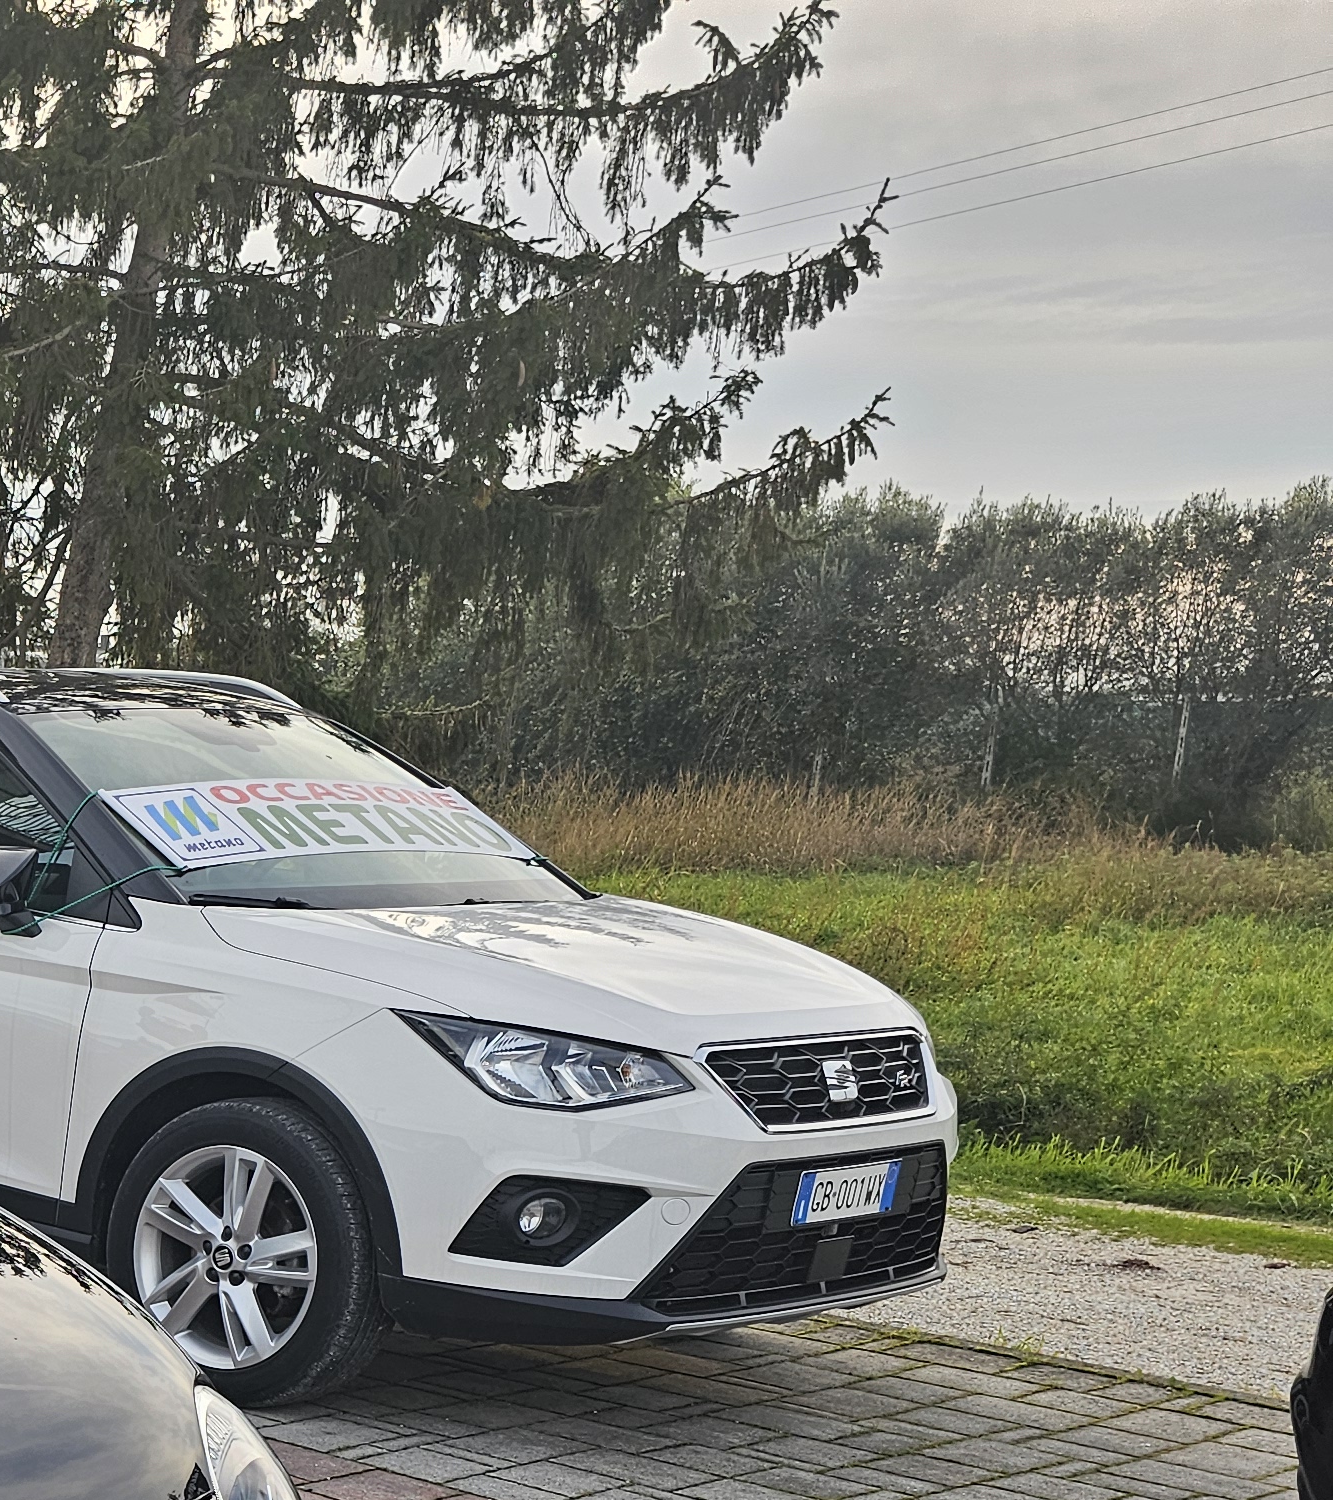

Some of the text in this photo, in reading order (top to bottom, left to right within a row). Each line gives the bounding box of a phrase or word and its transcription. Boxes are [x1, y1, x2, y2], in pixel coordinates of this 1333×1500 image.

[209, 782, 470, 811] OCCASIONE
[236, 804, 514, 853] METANO
[183, 837, 245, 853] metano
